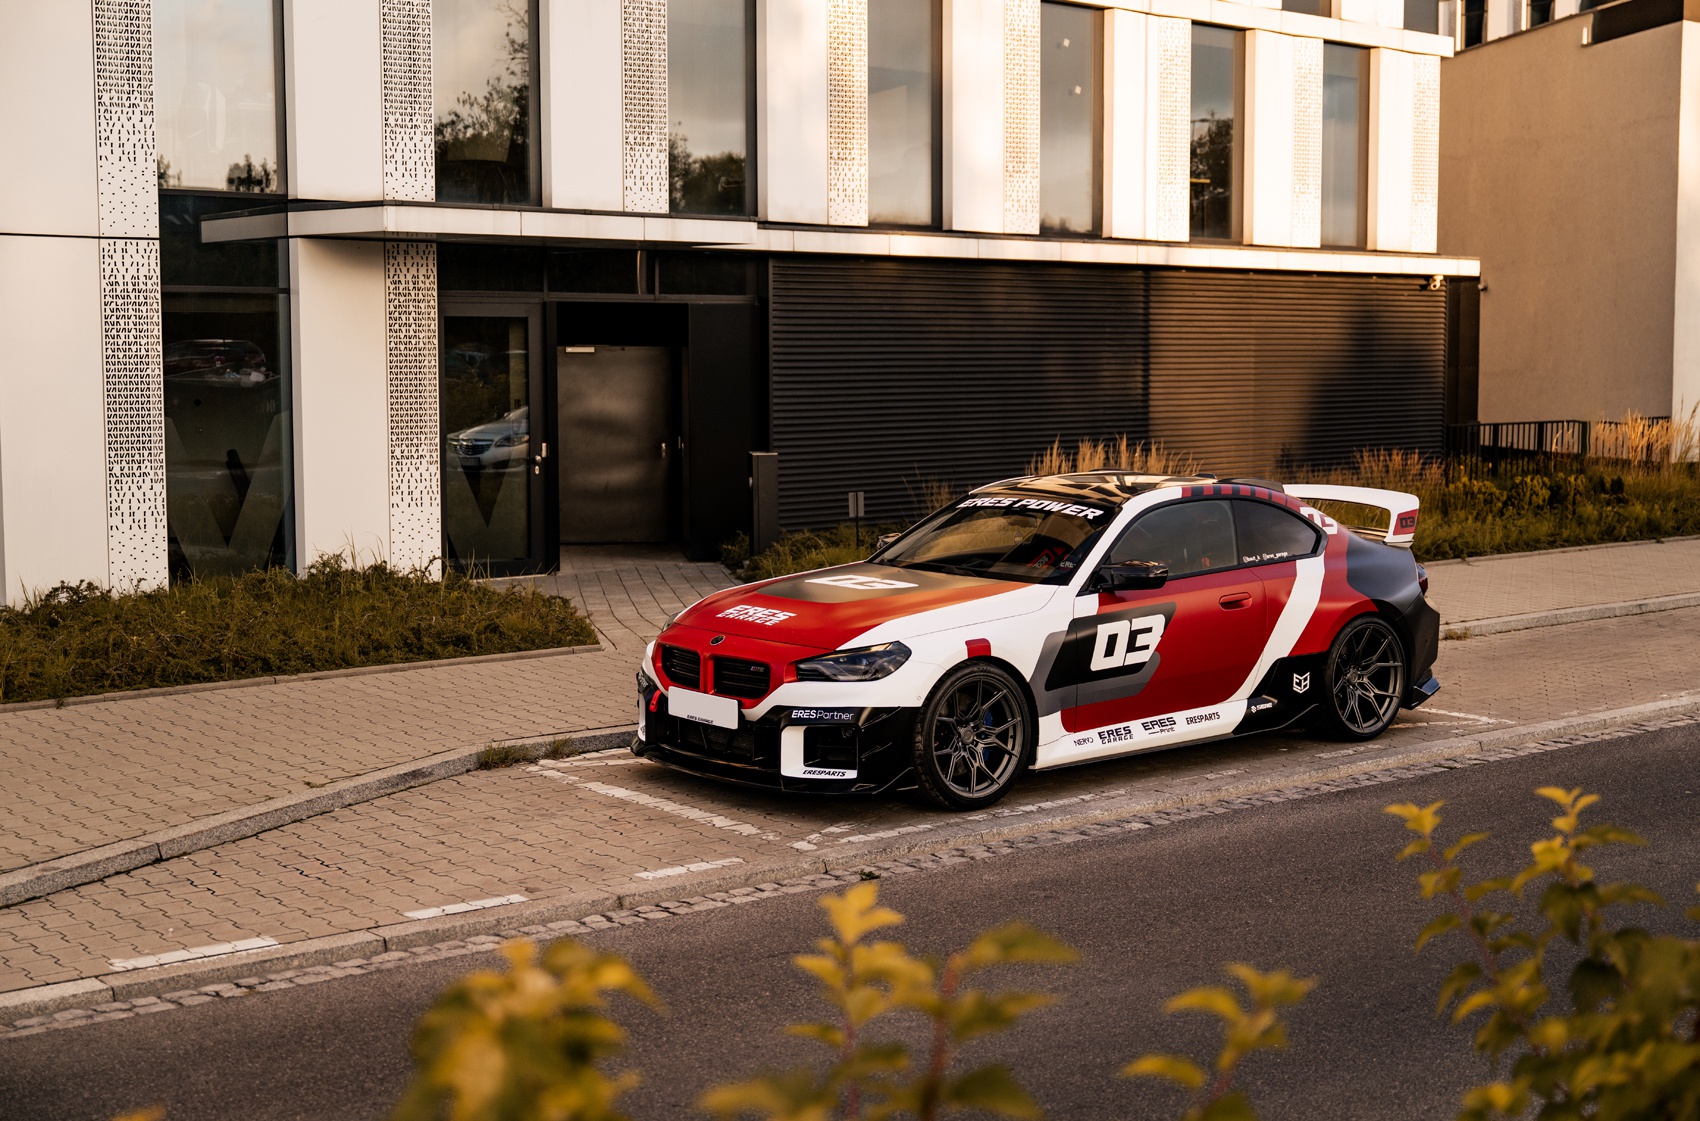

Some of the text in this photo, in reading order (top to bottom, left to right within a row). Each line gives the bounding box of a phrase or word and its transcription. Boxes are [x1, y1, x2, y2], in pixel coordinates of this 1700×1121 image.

[956, 498, 1104, 520] ERES POWER
[1400, 516, 1415, 529] 03
[804, 575, 919, 590] 03
[716, 613, 782, 626] GARAGE
[721, 604, 797, 621] ERES
[1090, 614, 1166, 672] 03
[1141, 717, 1177, 731] ERES
[1185, 711, 1221, 726] ERESPARTS
[1097, 725, 1132, 740] ERES
[1160, 726, 1176, 735] Print
[1101, 733, 1134, 745] GARAGE
[802, 769, 847, 778] ERESPARTS
